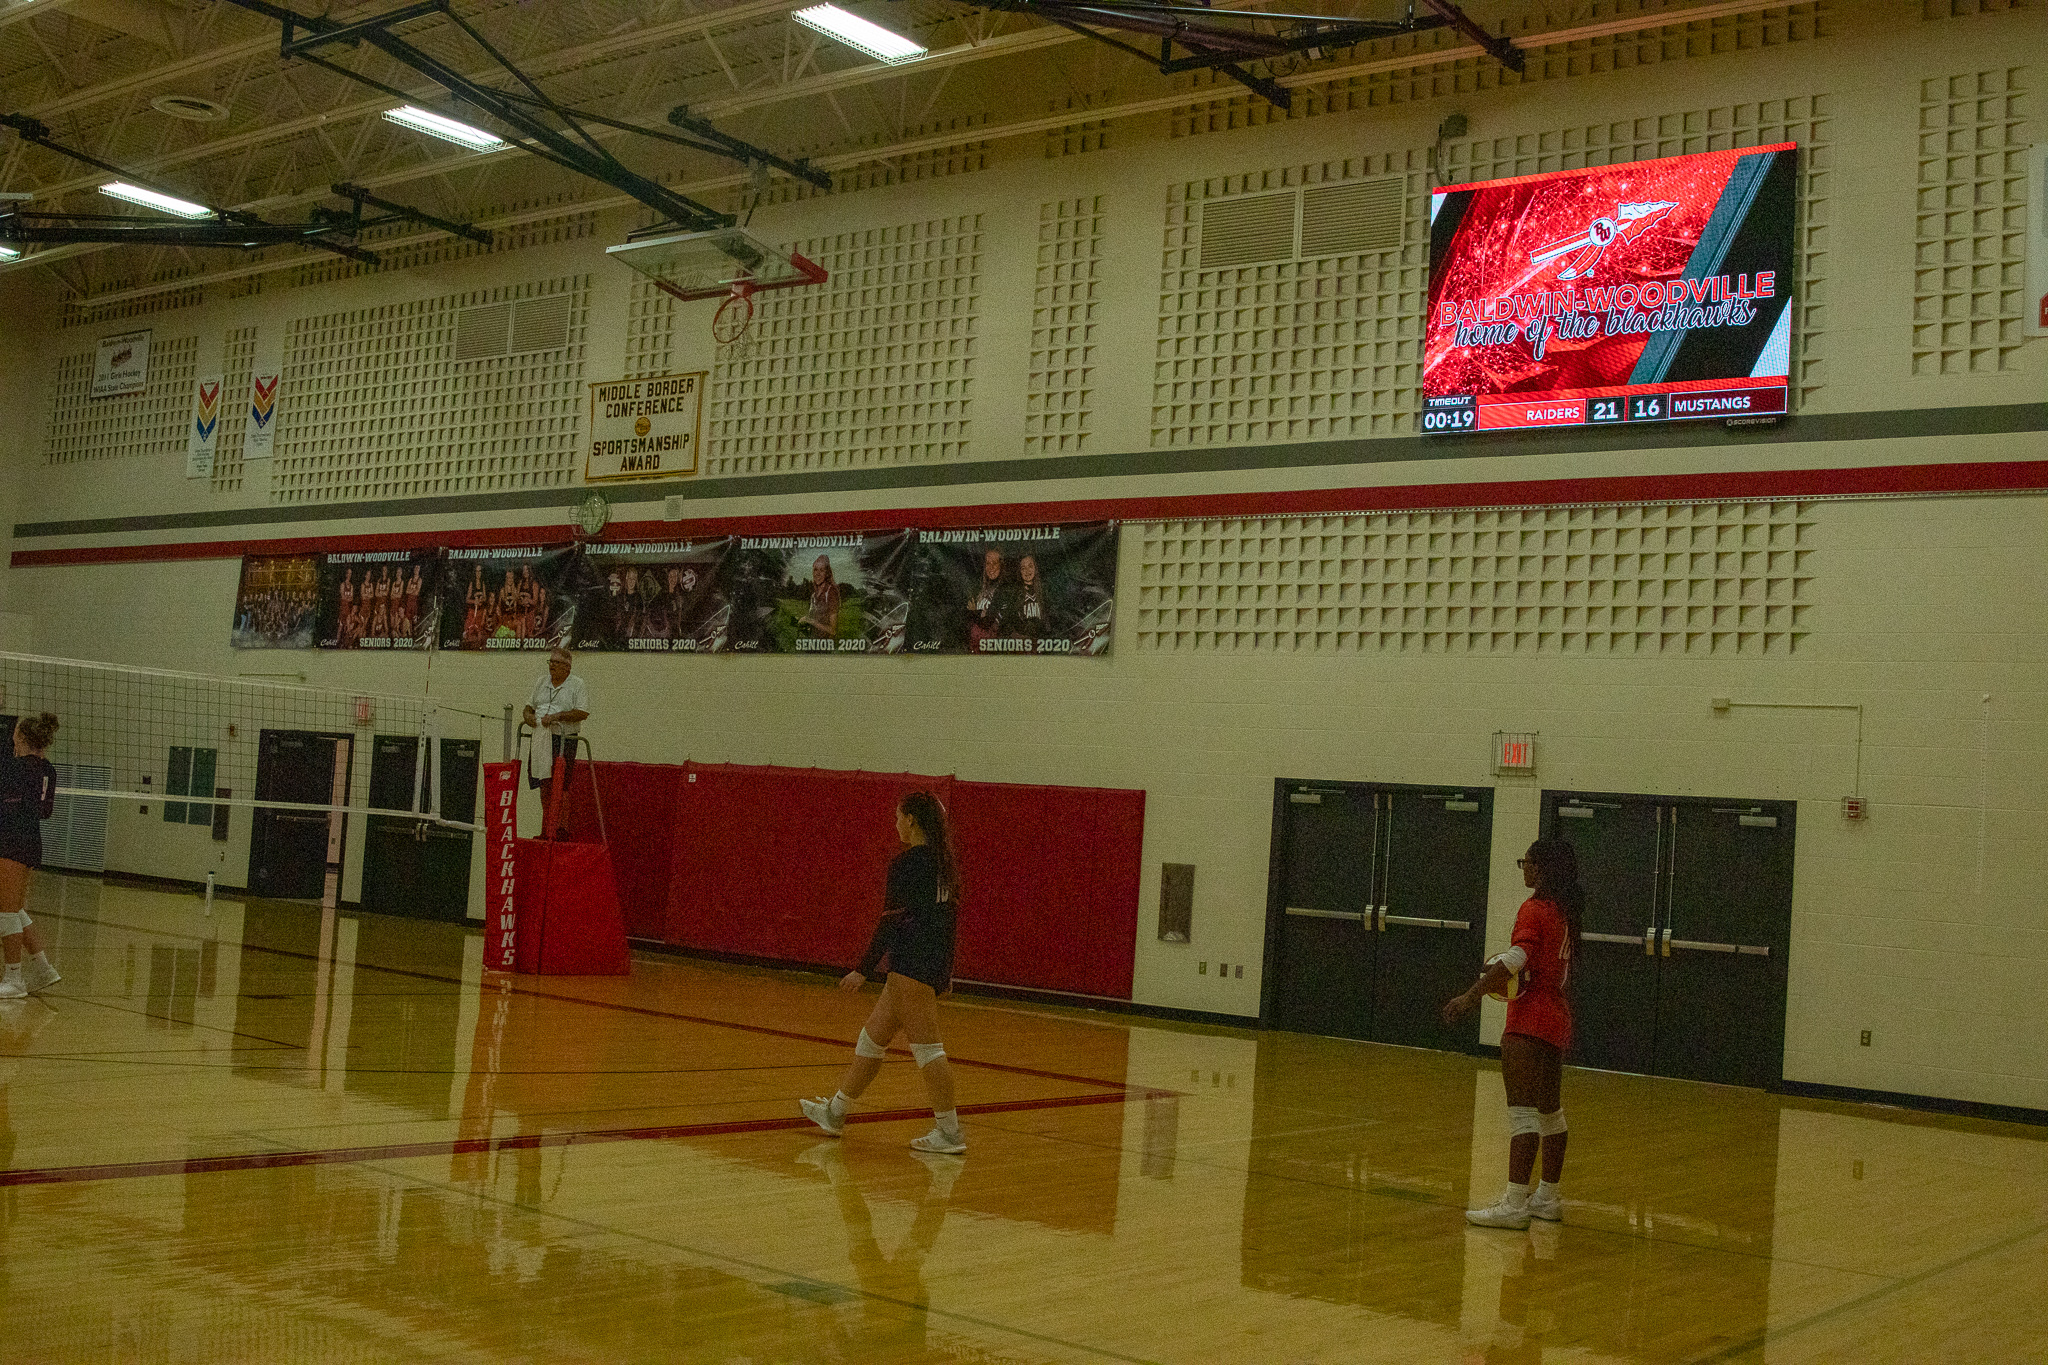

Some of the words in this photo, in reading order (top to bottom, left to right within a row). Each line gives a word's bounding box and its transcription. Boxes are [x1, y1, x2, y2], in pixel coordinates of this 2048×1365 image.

[1440, 271, 1775, 326] BALDWIN-WOODVILLE
[1453, 317, 1518, 347] home
[1525, 312, 1554, 360] of
[1558, 309, 1599, 339] the
[1606, 297, 1756, 335] blackhawks
[598, 384, 642, 402] MIDDLE
[647, 378, 694, 397] BORDER
[606, 397, 685, 418] CONFERENCE
[1428, 396, 1472, 407] TIMEOUT
[1634, 398, 1661, 418] 16
[1674, 395, 1751, 412] MUSTANGS
[1526, 406, 1580, 421] RAIDERS
[1593, 402, 1619, 420] 21
[1424, 410, 1474, 430] 00:19
[593, 433, 690, 457] SPORTSMANSHIP
[620, 455, 660, 472] AWARD
[741, 535, 864, 550] BALDWIN-WOODVILLE
[919, 527, 1060, 543] BALDWIN-WOODVILLE
[448, 547, 543, 560] BALDWIN-WOODVILLE
[585, 541, 692, 555] BALDWIN-WOODVILLE
[327, 551, 411, 564] BALDWIN-WOODVILLE
[359, 637, 391, 648] SENIORS
[393, 637, 413, 648] 2020
[486, 638, 521, 649] SENIORS
[523, 638, 546, 649] 2020
[628, 638, 669, 650] SENIORS
[672, 638, 697, 650] 2020
[795, 638, 834, 651] SENIOR
[837, 638, 866, 651] 2020
[913, 640, 941, 650] Cahill
[979, 639, 1032, 651] SENIORS
[1036, 639, 1070, 651] 2020
[1504, 743, 1528, 764] EXIT
[499, 790, 516, 966] BLACKHAWKS
